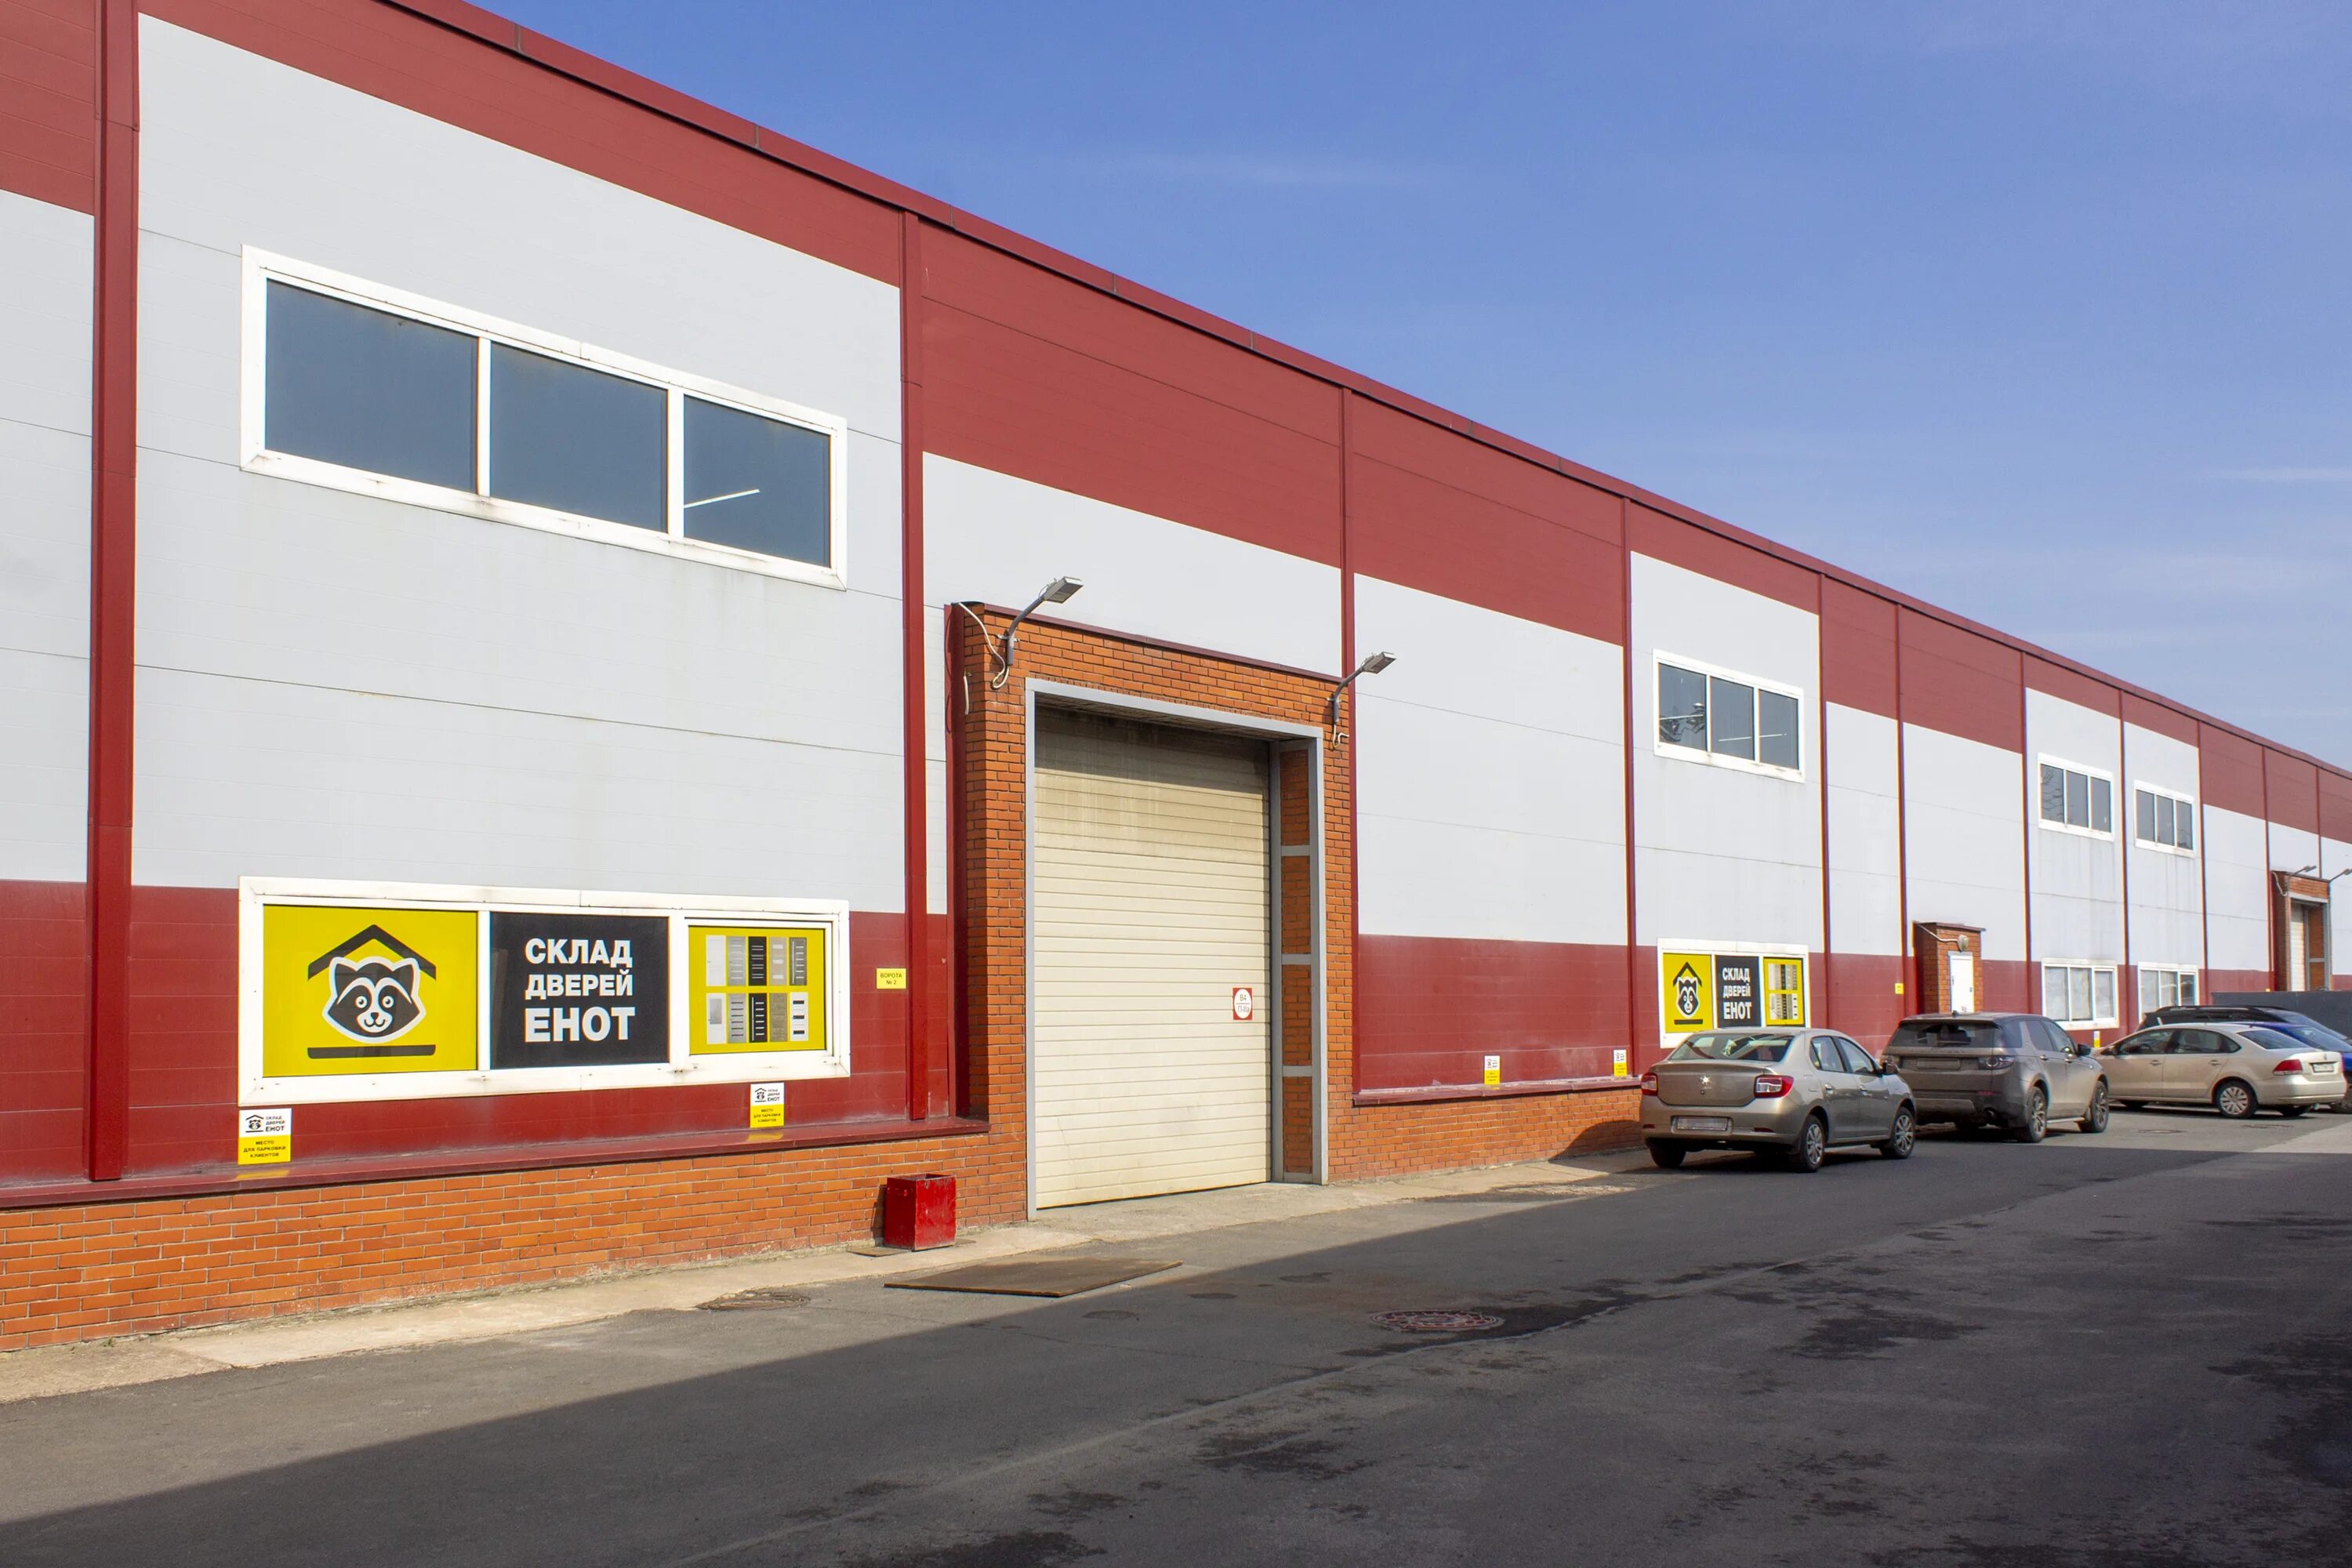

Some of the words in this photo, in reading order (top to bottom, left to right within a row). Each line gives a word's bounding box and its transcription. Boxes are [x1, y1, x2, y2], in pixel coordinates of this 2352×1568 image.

[525, 938, 633, 968] СКЛАД
[524, 968, 633, 1000] ДВЕРЕЙ
[1722, 967, 1751, 982] СКЛАД
[1722, 983, 1751, 999] ДВЕРЕЙ
[1723, 1001, 1753, 1020] ЕНОТ
[524, 1006, 636, 1043] ЕНОТ
